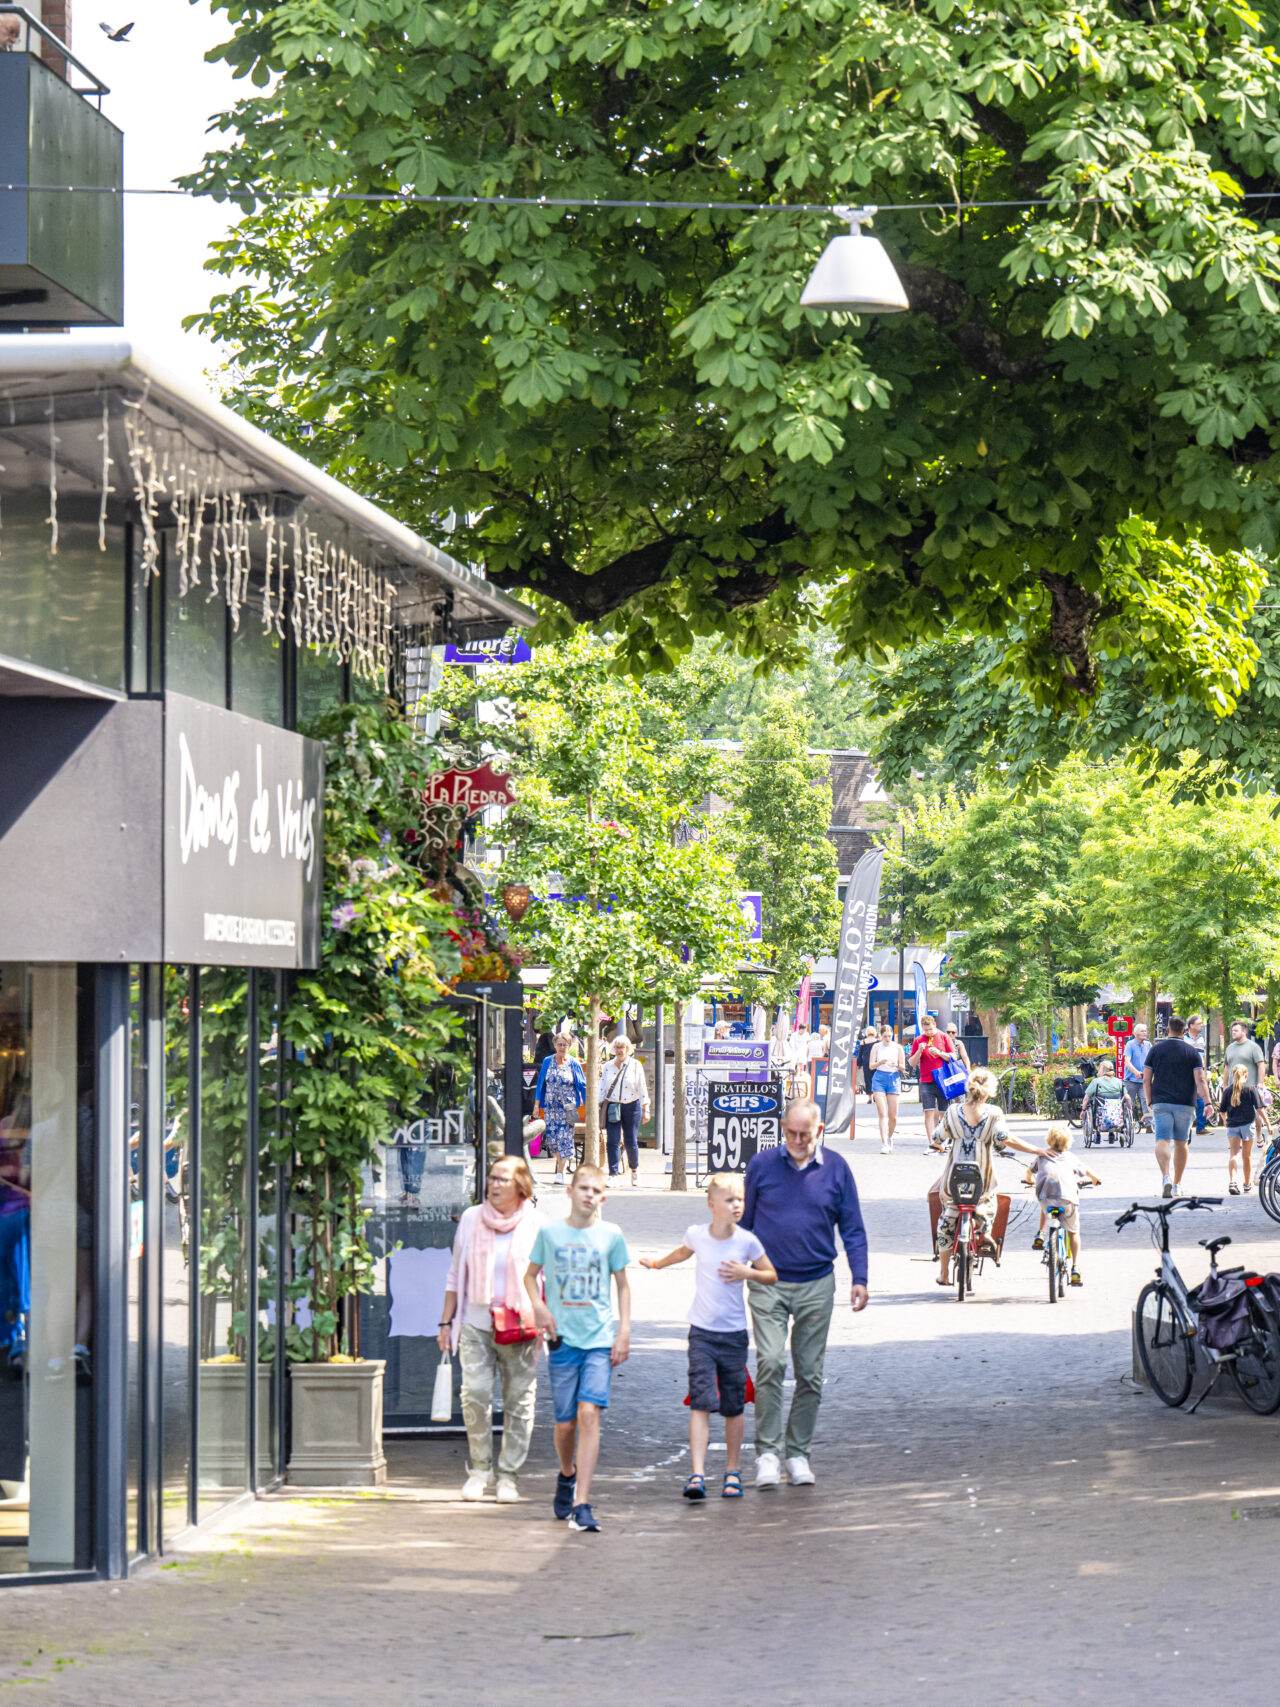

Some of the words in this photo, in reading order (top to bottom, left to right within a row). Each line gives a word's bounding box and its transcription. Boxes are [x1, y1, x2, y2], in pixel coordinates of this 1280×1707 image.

[454, 775, 507, 804] PIEDRA
[179, 732, 240, 866] Dames
[250, 744, 271, 854] de
[277, 780, 316, 882] Vries
[864, 904, 879, 958] FASHION
[830, 899, 866, 1095] FRATELLO'S
[714, 1084, 778, 1094] FRATELLO'S
[718, 1096, 760, 1108] cars
[761, 1120, 774, 1134] 2
[554, 1247, 601, 1273] SEA
[555, 1273, 601, 1300] YOU
